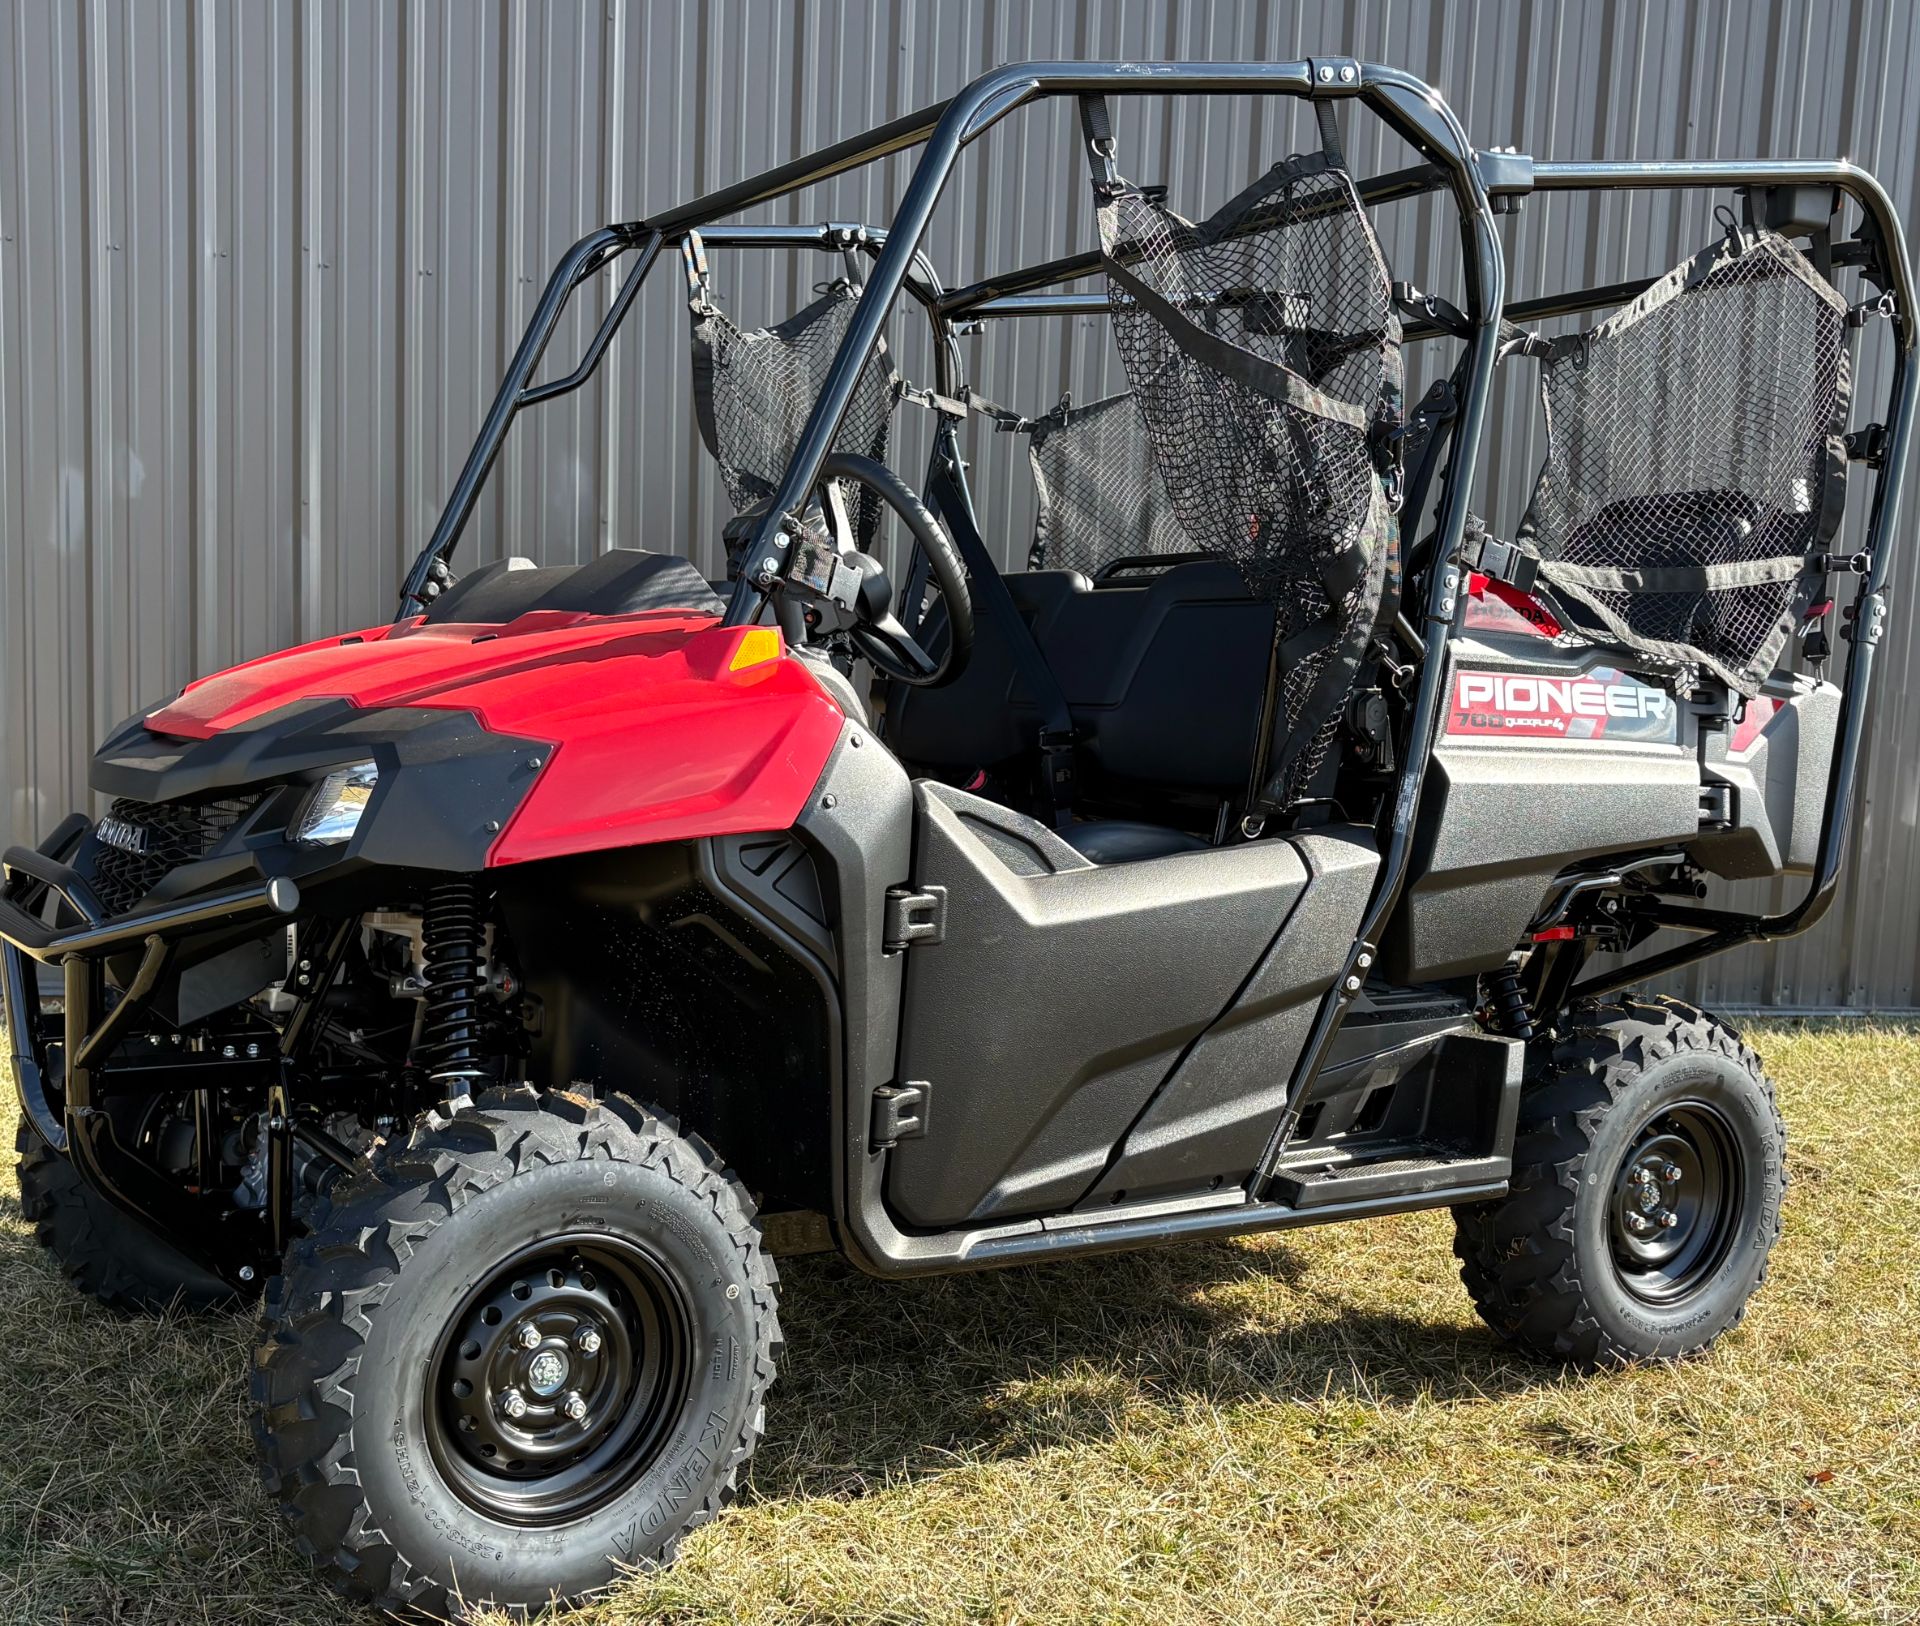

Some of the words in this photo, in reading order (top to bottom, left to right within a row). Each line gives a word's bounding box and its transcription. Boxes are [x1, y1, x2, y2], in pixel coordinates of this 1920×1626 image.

[1472, 604, 1545, 623] HONDA
[1460, 675, 1667, 720] PIONEER
[1455, 712, 1504, 729] 700
[1753, 1134, 1777, 1250] KENDA
[611, 1410, 729, 1554] KENDA
